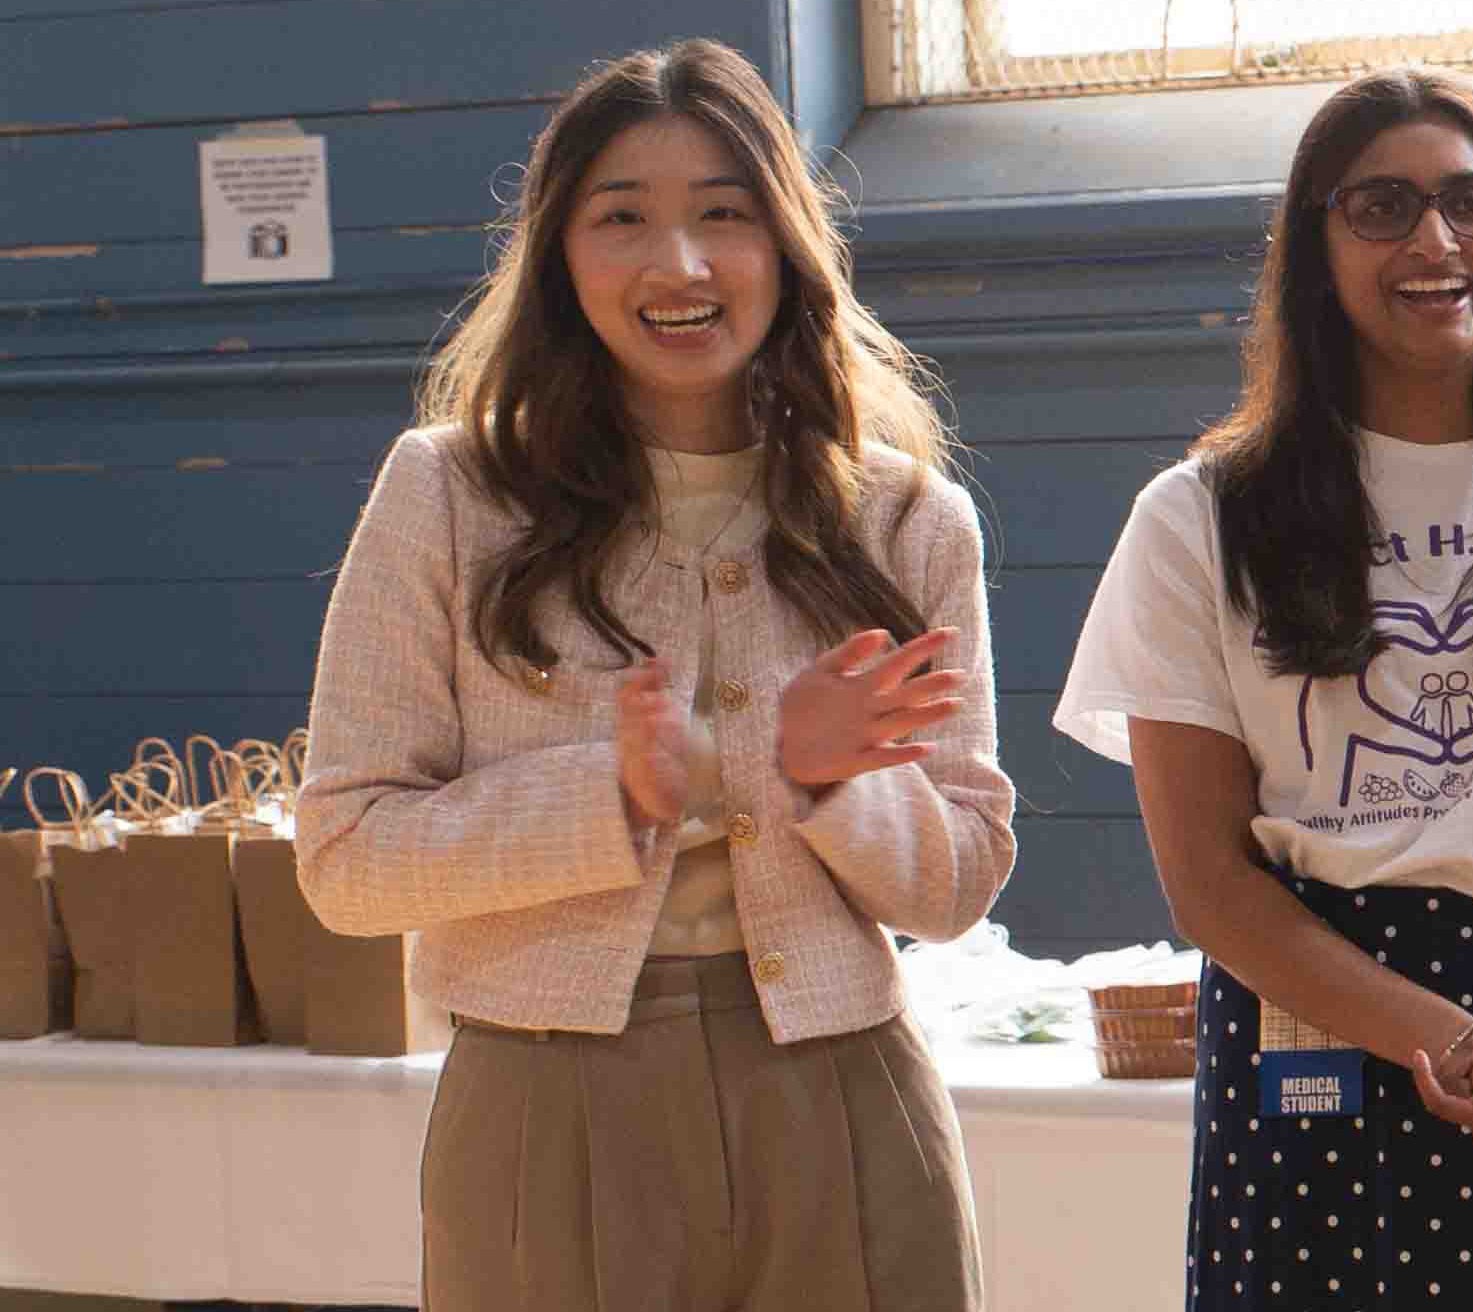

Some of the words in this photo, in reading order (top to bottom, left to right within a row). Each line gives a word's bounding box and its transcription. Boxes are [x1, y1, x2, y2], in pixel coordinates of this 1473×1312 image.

[1350, 806, 1419, 827] Attitudes
[1281, 1076, 1341, 1095] MEDICAL
[1280, 1095, 1343, 1114] STUDENT
